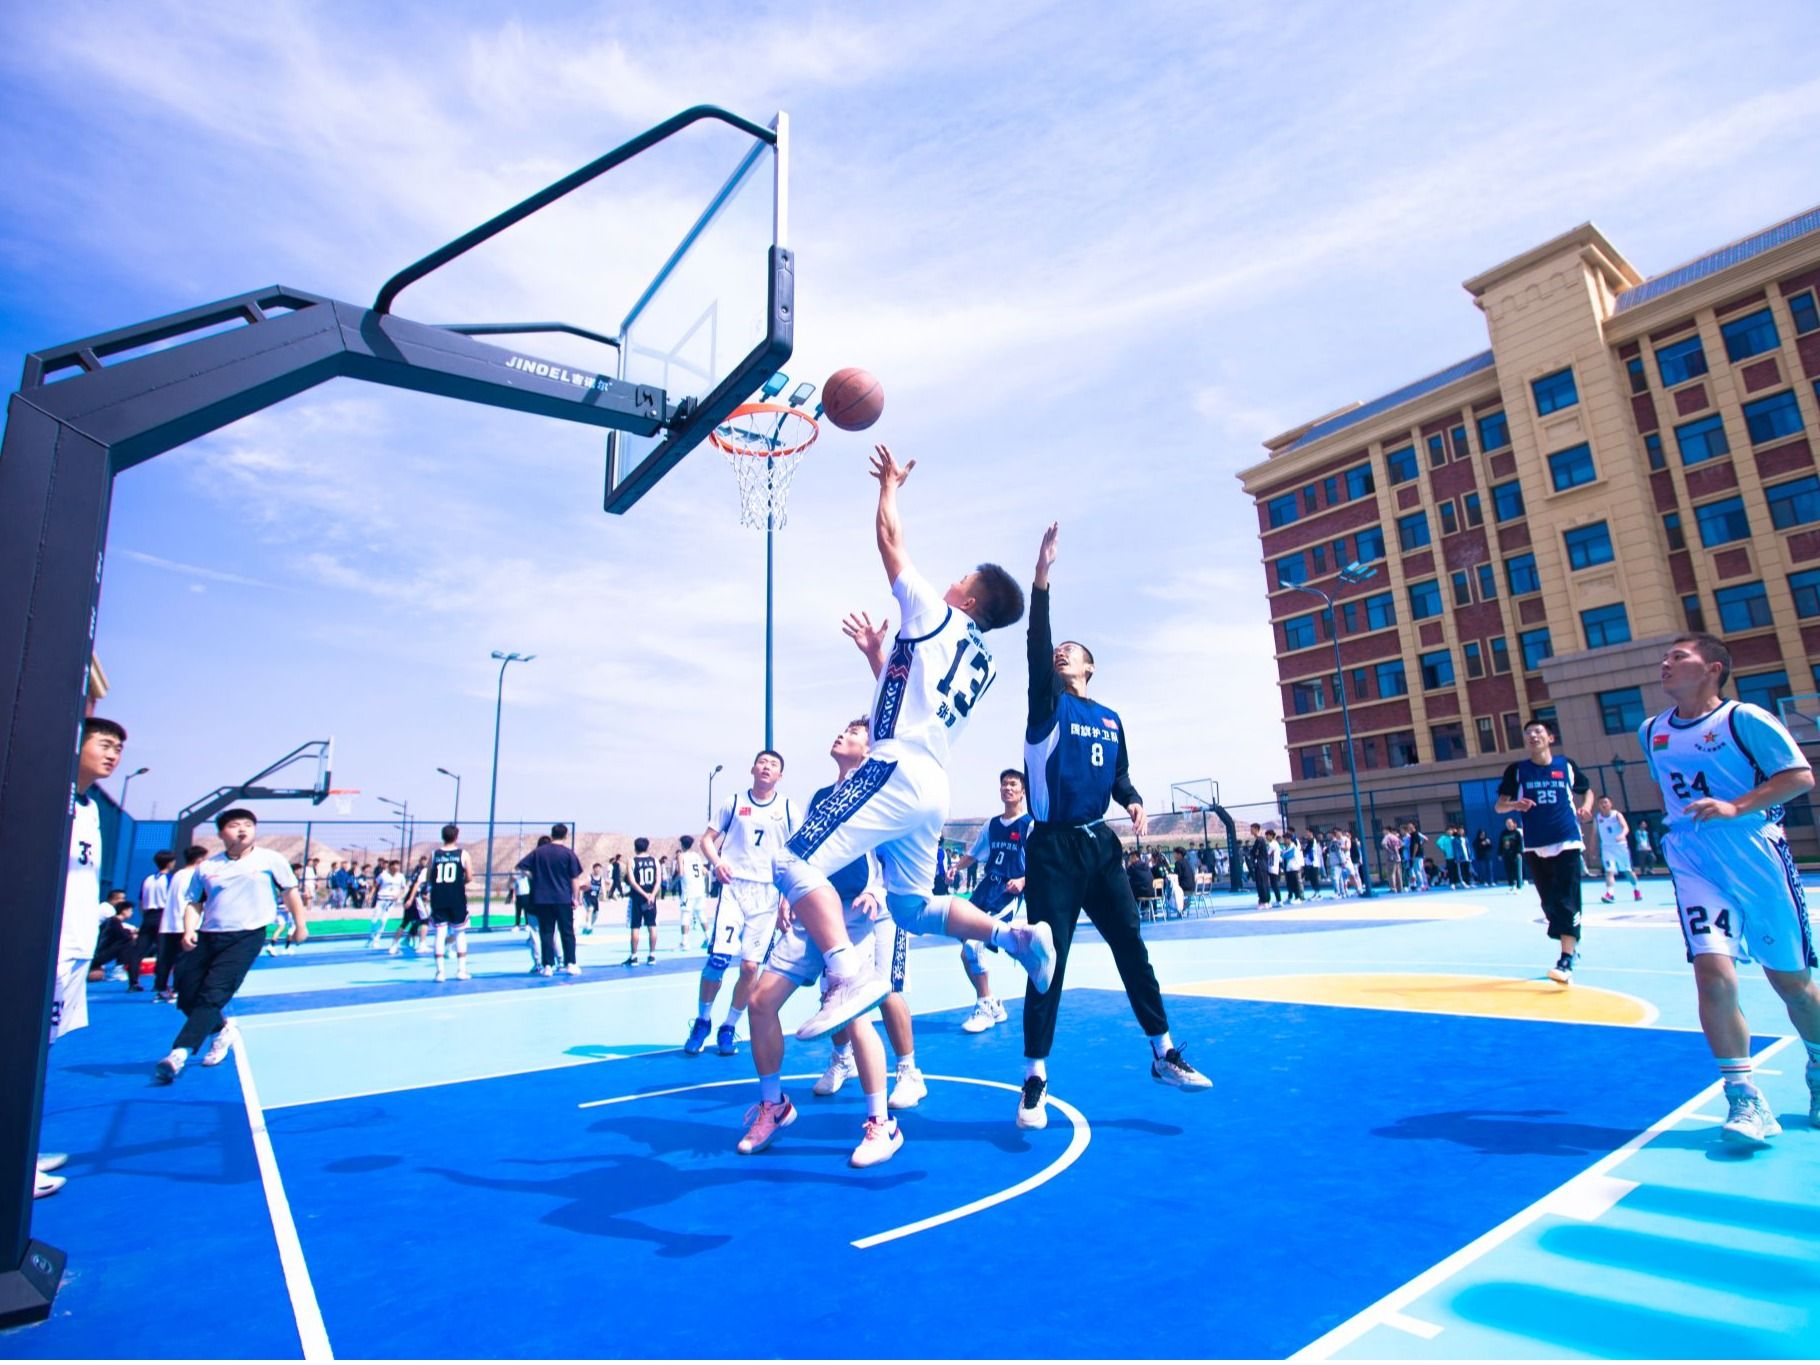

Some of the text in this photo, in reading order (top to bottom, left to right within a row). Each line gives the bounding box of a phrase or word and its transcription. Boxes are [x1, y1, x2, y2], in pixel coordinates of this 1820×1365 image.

[505, 356, 570, 382] JINOEL
[936, 638, 989, 718] 13
[1070, 722, 1119, 744] 国旗护卫队
[1091, 742, 1104, 767] 8
[1669, 770, 1713, 799] 24
[1537, 789, 1557, 804] 25
[754, 829, 764, 846] 7
[435, 862, 457, 884] 10
[639, 867, 655, 886] 10
[692, 863, 700, 878] 5
[1686, 905, 1733, 938] 24
[725, 926, 735, 943] 7
